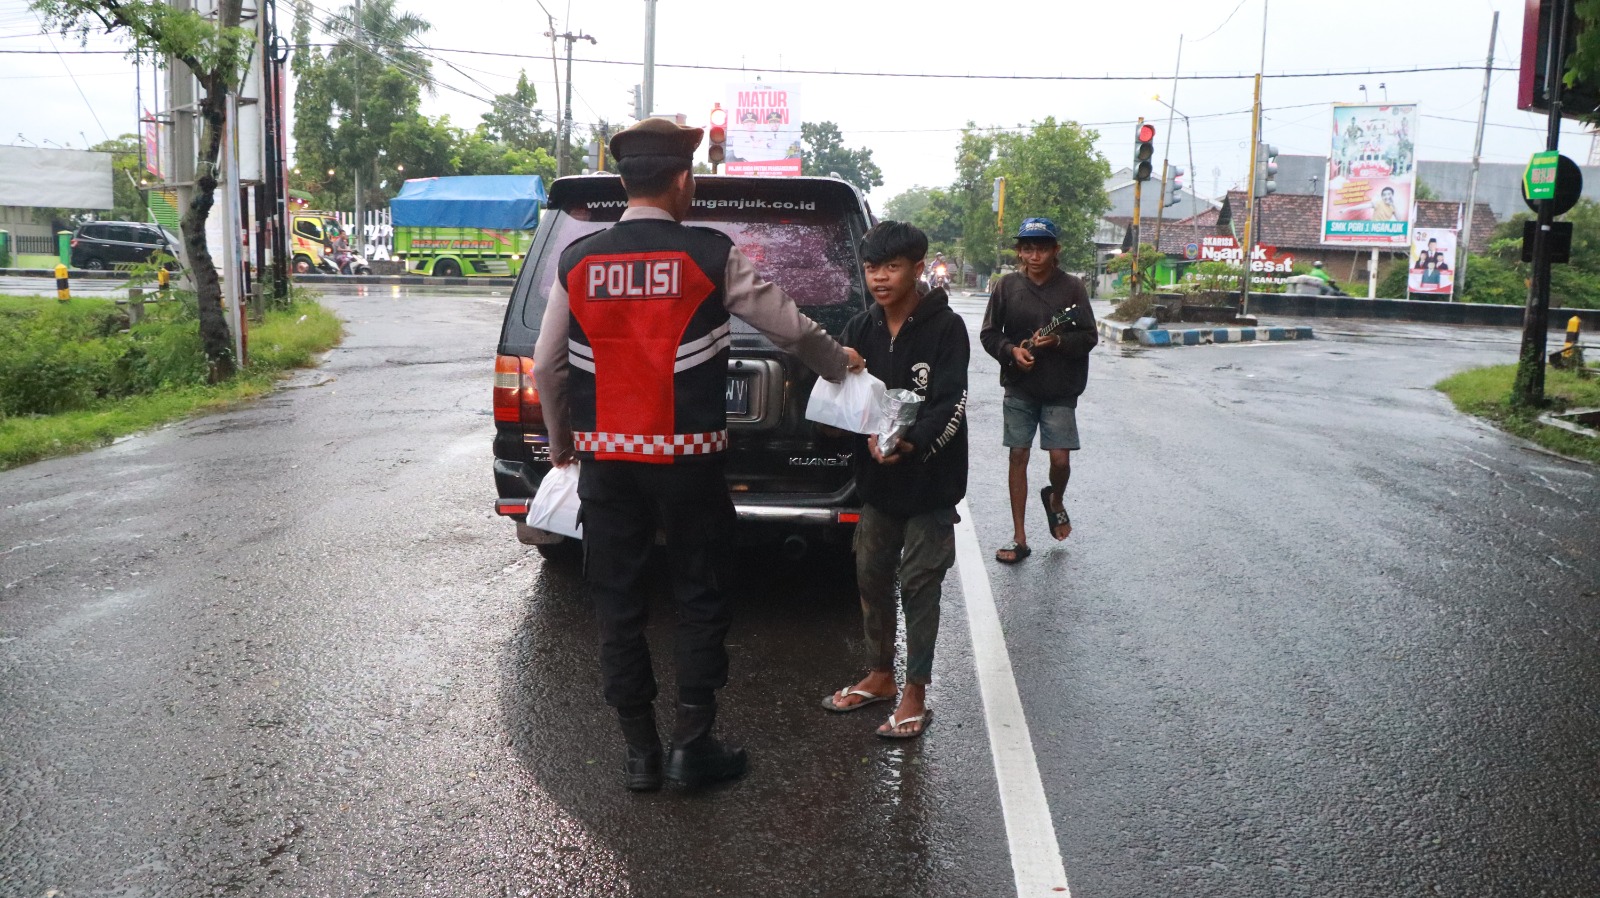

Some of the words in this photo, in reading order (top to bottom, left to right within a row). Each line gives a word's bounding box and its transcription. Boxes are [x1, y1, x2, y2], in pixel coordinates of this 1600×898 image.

[738, 91, 787, 107] MATUR
[1331, 222, 1347, 232] SMK
[1348, 222, 1364, 232] PGRI
[1364, 223, 1369, 232] 1
[1371, 223, 1404, 233] NGANJUK
[1202, 245, 1267, 261] Ngank
[588, 261, 679, 297] POLISI
[789, 457, 837, 466] KIJANG
